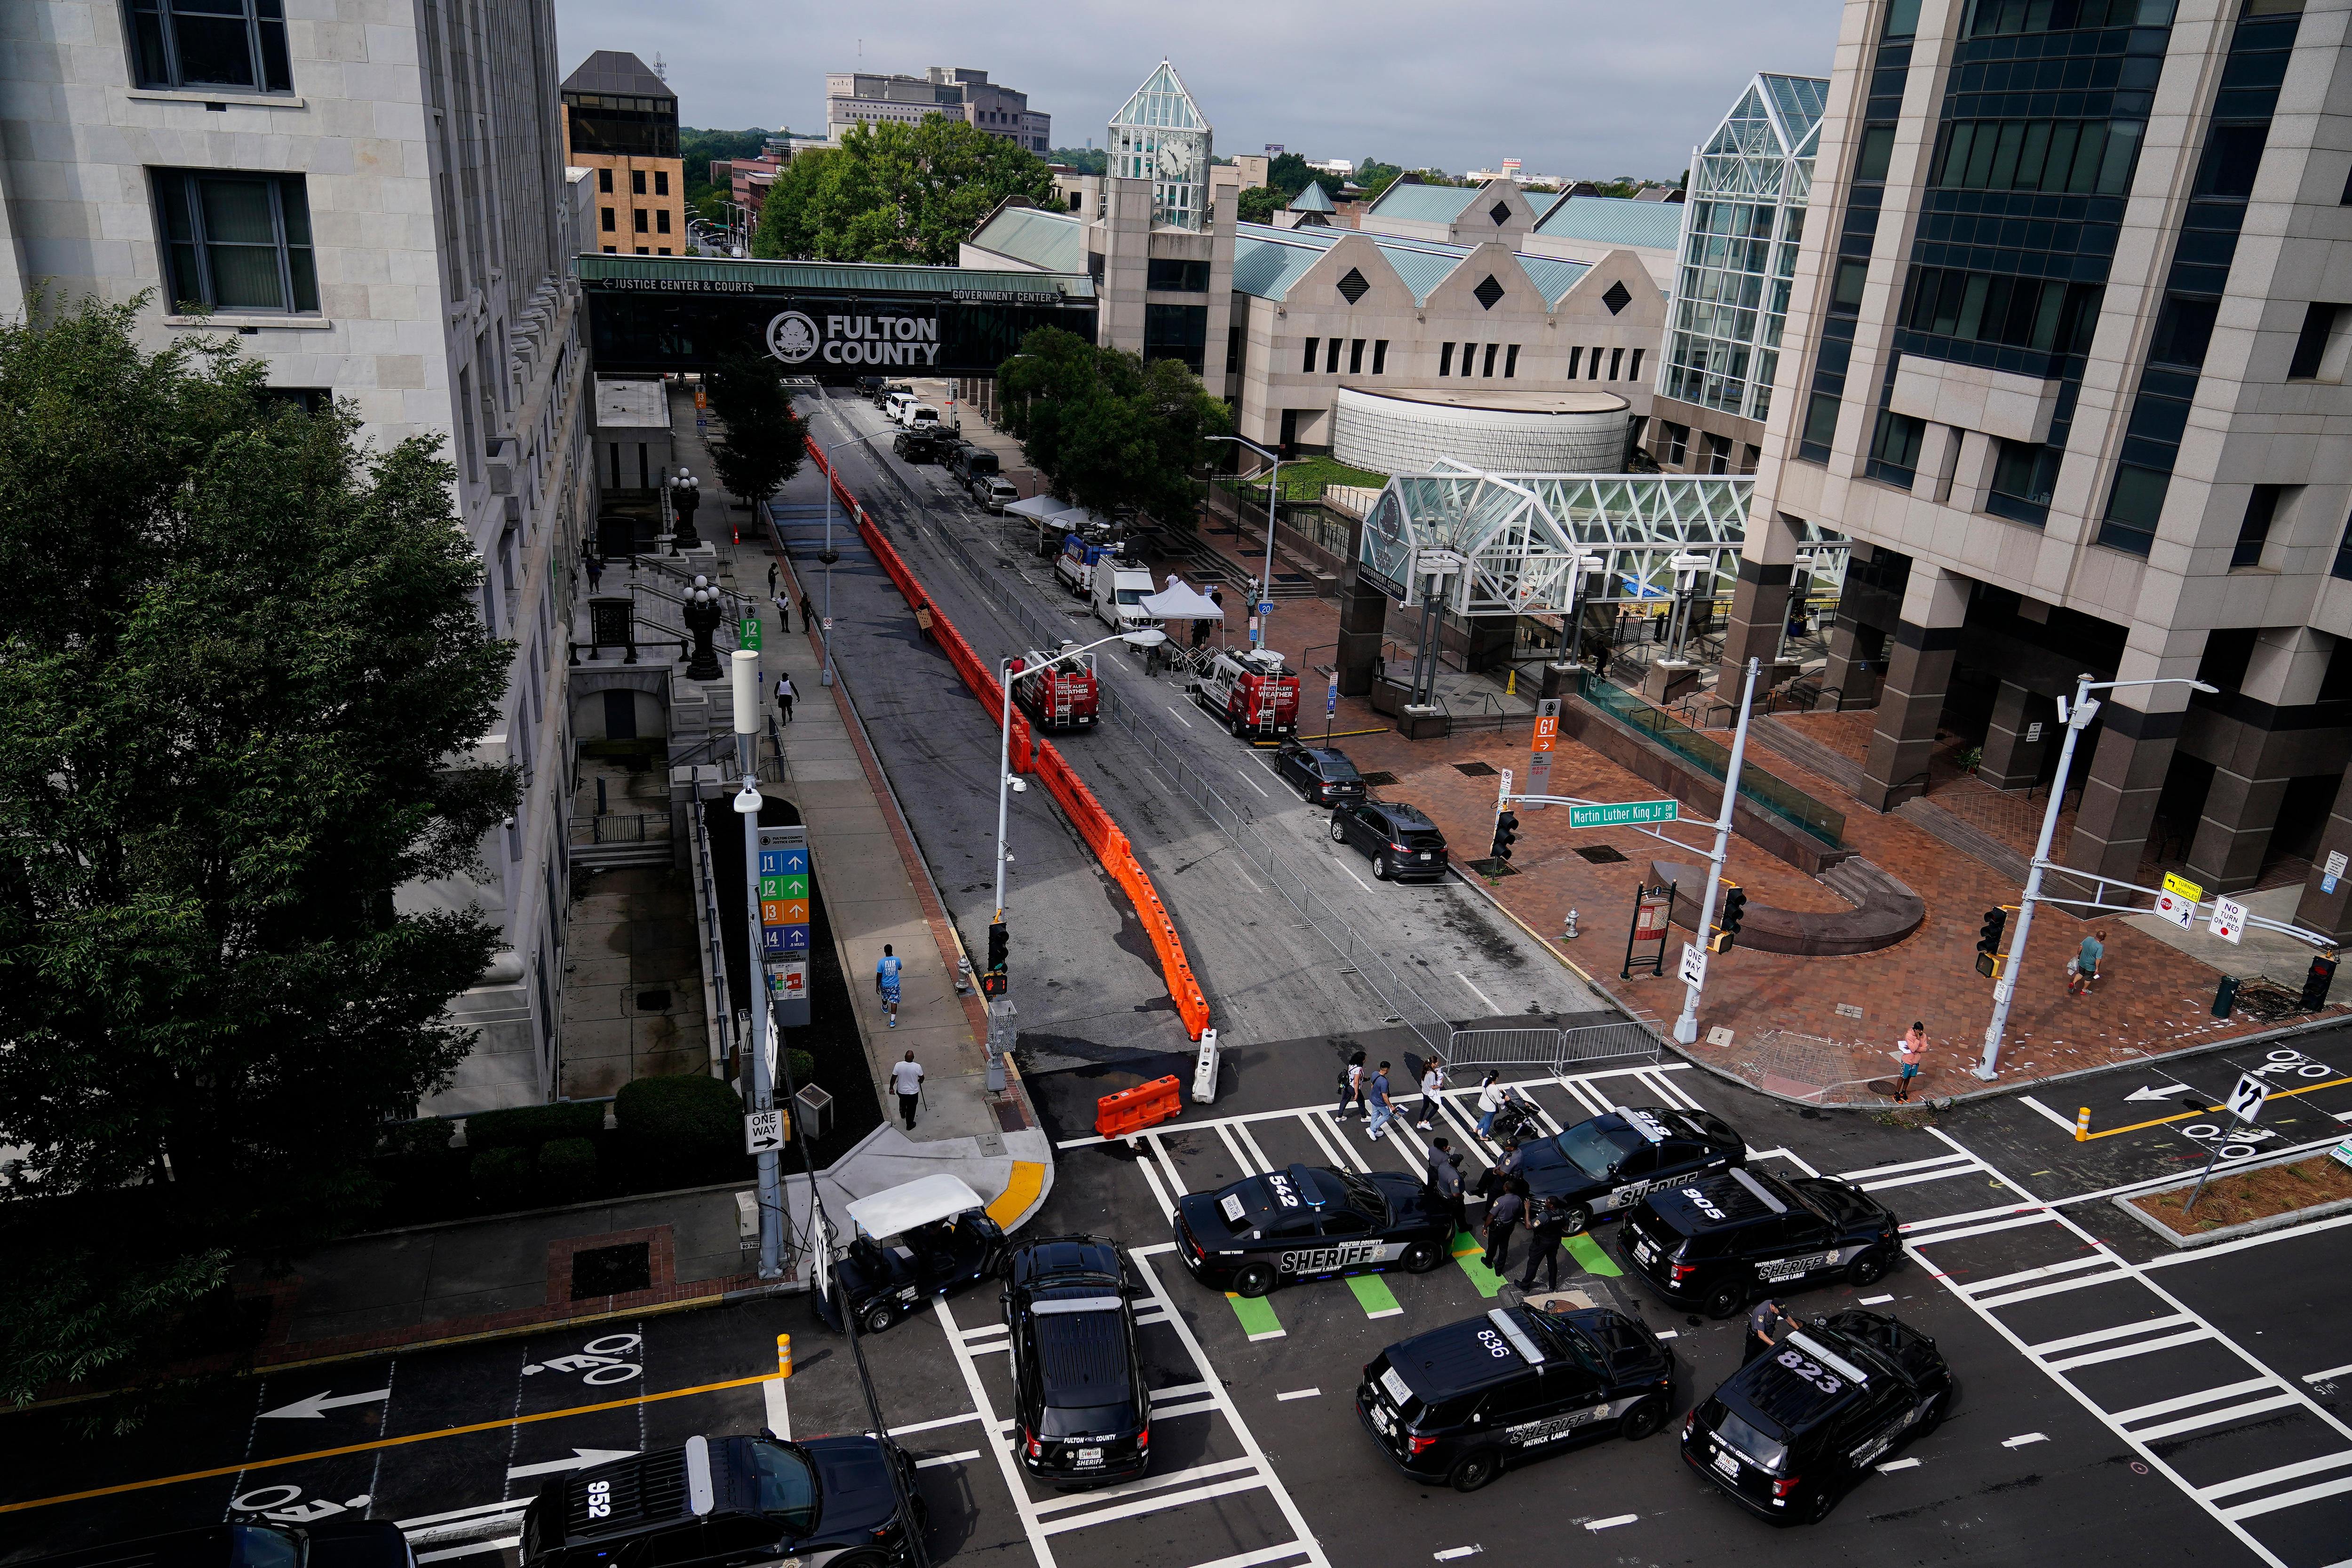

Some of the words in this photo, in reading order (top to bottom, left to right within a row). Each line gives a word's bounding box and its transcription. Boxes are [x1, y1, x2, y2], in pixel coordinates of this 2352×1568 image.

[615, 279, 656, 289] JUSTICE
[660, 280, 699, 291] CENTER
[704, 282, 711, 290] &
[715, 282, 754, 292] COURTS
[953, 290, 1013, 301] GOVERNMENT
[1017, 292, 1051, 302] CENTER
[827, 315, 937, 341] FULTON
[823, 341, 940, 366] COUNTY
[698, 393, 704, 402] J3
[1361, 564, 1387, 587] GOVERNMENT
[1388, 579, 1403, 595] CENTER
[745, 621, 757, 637] J2
[1216, 665, 1237, 690] ANF
[1540, 719, 1554, 735] G1
[1574, 810, 1599, 823] Martin
[1603, 808, 1629, 821] Luther
[1633, 806, 1650, 821] King
[1653, 805, 1661, 817] Jr
[762, 856, 773, 872] J1
[763, 881, 776, 897] J2
[2176, 887, 2197, 900] VEHICLES
[2178, 880, 2199, 893] TURNING
[764, 905, 776, 921] J3
[2225, 903, 2238, 914] NO
[2221, 911, 2238, 923] TURN
[2226, 922, 2239, 932] RED
[764, 931, 778, 947] J4
[1688, 949, 1702, 963] ONE
[1686, 958, 1700, 973] WAY
[753, 1114, 776, 1126] ONE
[753, 1124, 777, 1137] WAY
[1269, 1176, 1299, 1207] 542
[1612, 1184, 1630, 1194] FULTON
[1631, 1179, 1650, 1189] COUNTY
[1682, 1188, 1726, 1219] 905
[1631, 1223, 1643, 1235] FULTON
[1648, 1240, 1661, 1252] COUNTY
[1280, 1246, 1374, 1273] SHERIFF
[1634, 1248, 1649, 1264] SHERIFF
[1296, 1267, 1321, 1275] PATRICK
[1759, 1256, 1823, 1280] SHERIFF
[1769, 1274, 1789, 1283] PATRICK
[1478, 1329, 1510, 1358] 836
[1777, 1351, 1842, 1394] 823
[1399, 1382, 1407, 1393] TWICE
[1370, 1409, 1388, 1434] SHERIFF
[1506, 1425, 1523, 1433] FULTON
[1523, 1420, 1541, 1428] COUNTY
[1510, 1412, 1589, 1444] SHERIFF
[1523, 1435, 1548, 1448] PATRICK
[1551, 1429, 1570, 1441] LABAT
[1709, 1431, 1727, 1447] FULTON
[1735, 1450, 1755, 1465] COUNTY
[1850, 1448, 1861, 1458] FULTON
[1861, 1438, 1873, 1451] COUNTY
[1876, 1443, 1888, 1457] LABAT
[1076, 1458, 1104, 1466] SHERIFF
[1714, 1459, 1738, 1478] SHERIFF
[588, 1481, 611, 1519] 952
